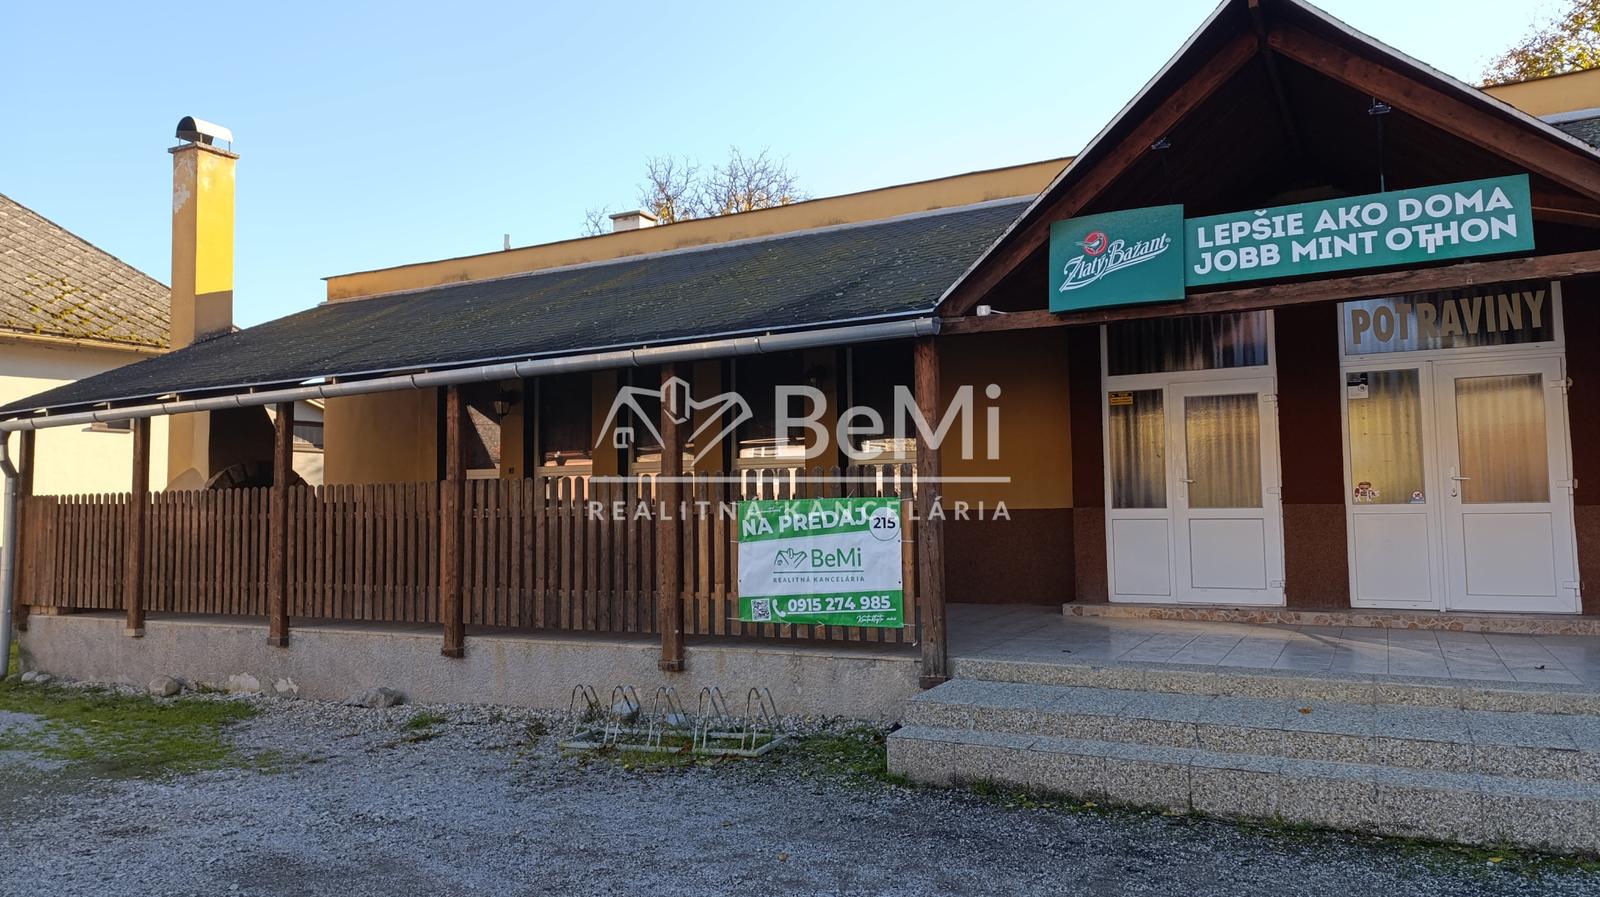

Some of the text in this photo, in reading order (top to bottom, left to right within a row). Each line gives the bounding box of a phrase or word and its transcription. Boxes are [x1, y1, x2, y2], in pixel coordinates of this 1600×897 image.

[1197, 187, 1514, 249] LEPŠIE AKO DOMA
[1059, 233, 1168, 292] Zlatý Bažant
[1193, 243, 1281, 275] JOBB
[1291, 230, 1378, 263] MINT
[1351, 290, 1546, 345] POTRAVINY
[742, 517, 774, 537] NA
[778, 507, 867, 534] PREDAJ
[873, 517, 896, 529] 215
[811, 547, 862, 568] BeMi
[787, 595, 891, 612] 0915 274 985
